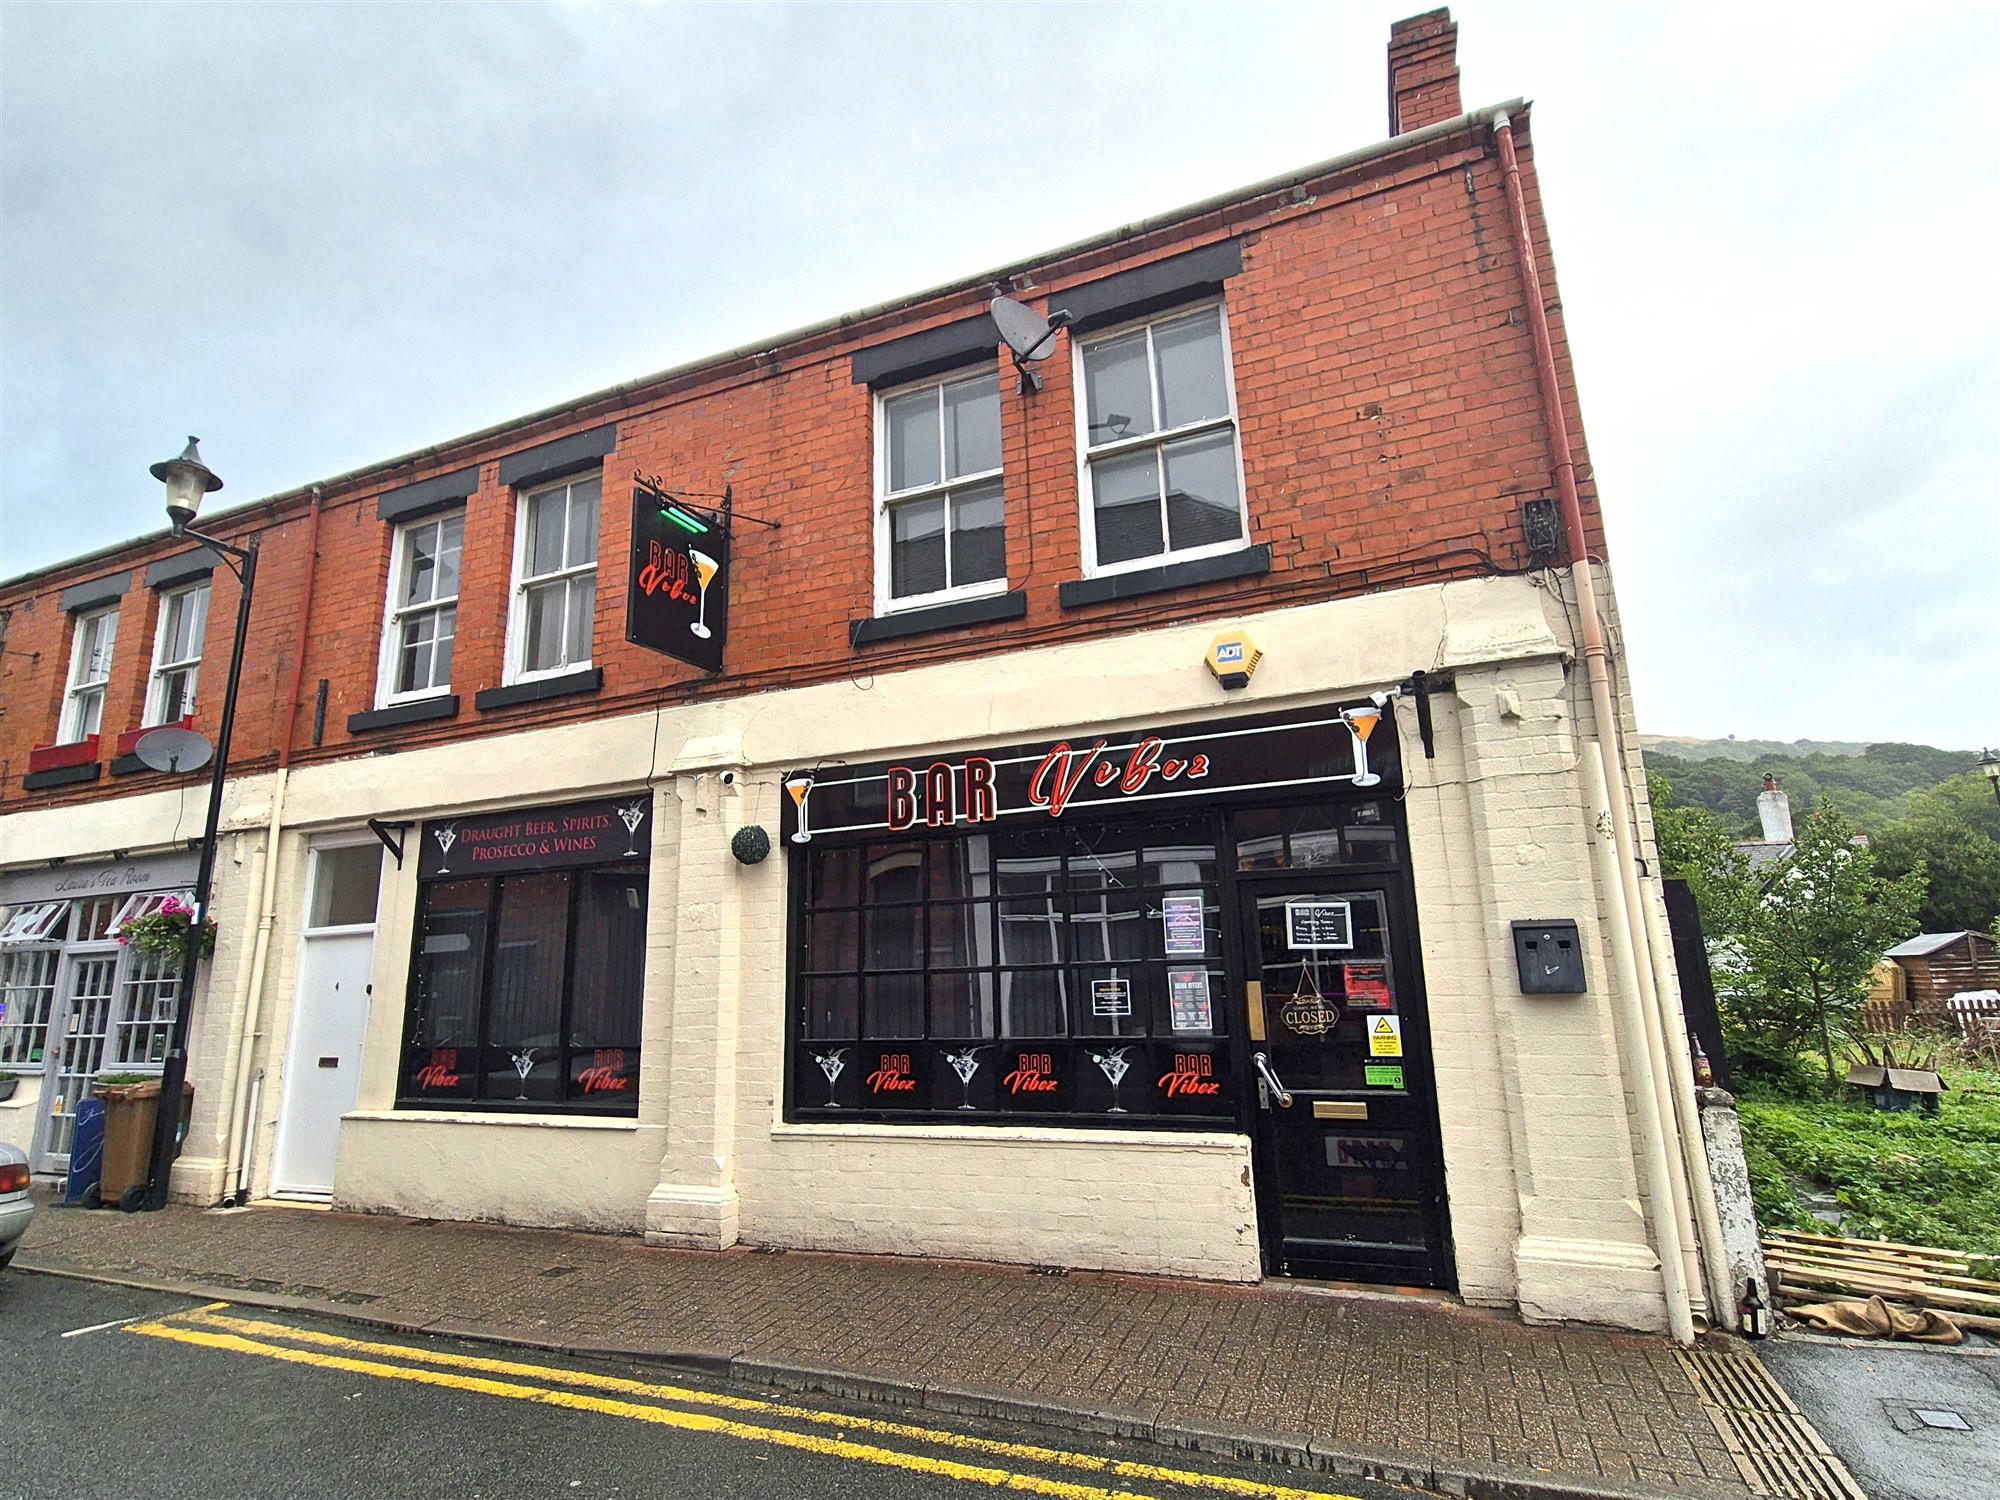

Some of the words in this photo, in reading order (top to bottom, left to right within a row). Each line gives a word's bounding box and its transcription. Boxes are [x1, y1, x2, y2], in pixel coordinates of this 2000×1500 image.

[650, 539, 689, 585] BAR
[1217, 645, 1242, 660] ADT
[888, 757, 998, 831] BAR
[1027, 736, 1209, 817] Vibez
[460, 824, 521, 844] DRAUGHT
[472, 843, 536, 861] PROSECCO
[539, 839, 550, 854] &
[554, 836, 598, 852] WINES
[98, 868, 117, 888] Tea
[124, 866, 151, 886] Room
[1285, 1010, 1335, 1025] CLOSED
[431, 1049, 459, 1071] BAR
[593, 1049, 625, 1072] BAR
[880, 1054, 910, 1073] BAR
[1018, 1053, 1051, 1074] BAR
[1174, 1054, 1212, 1077] BAR
[416, 1065, 460, 1089] Vibez
[577, 1067, 627, 1094] Vibez
[866, 1069, 916, 1095] Vibez
[1003, 1069, 1057, 1095] Vibez
[1157, 1070, 1220, 1098] Vibez
